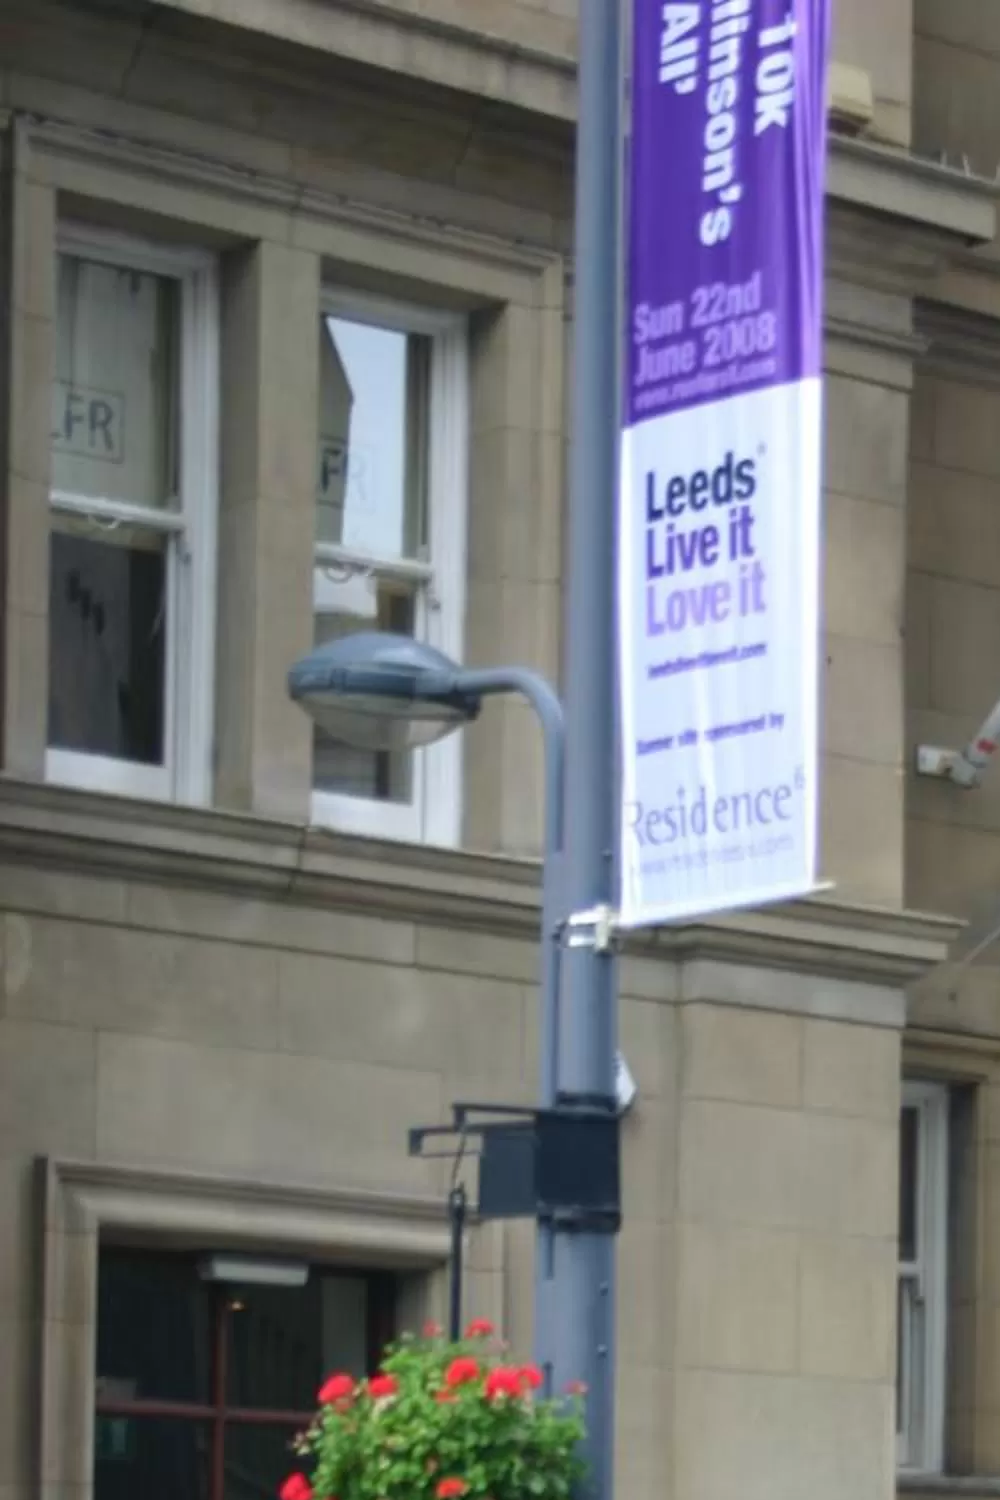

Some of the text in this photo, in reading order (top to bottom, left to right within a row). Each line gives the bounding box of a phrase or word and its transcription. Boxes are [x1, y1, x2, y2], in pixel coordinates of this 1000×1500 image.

[700, 0, 751, 247] linson's
[634, 271, 761, 345] Sun 22nd
[635, 340, 697, 388] June
[703, 312, 777, 366] 2008
[50, 393, 114, 452] FR
[646, 450, 756, 524] Leeds
[646, 505, 755, 581] Live it
[646, 561, 767, 638] Love it
